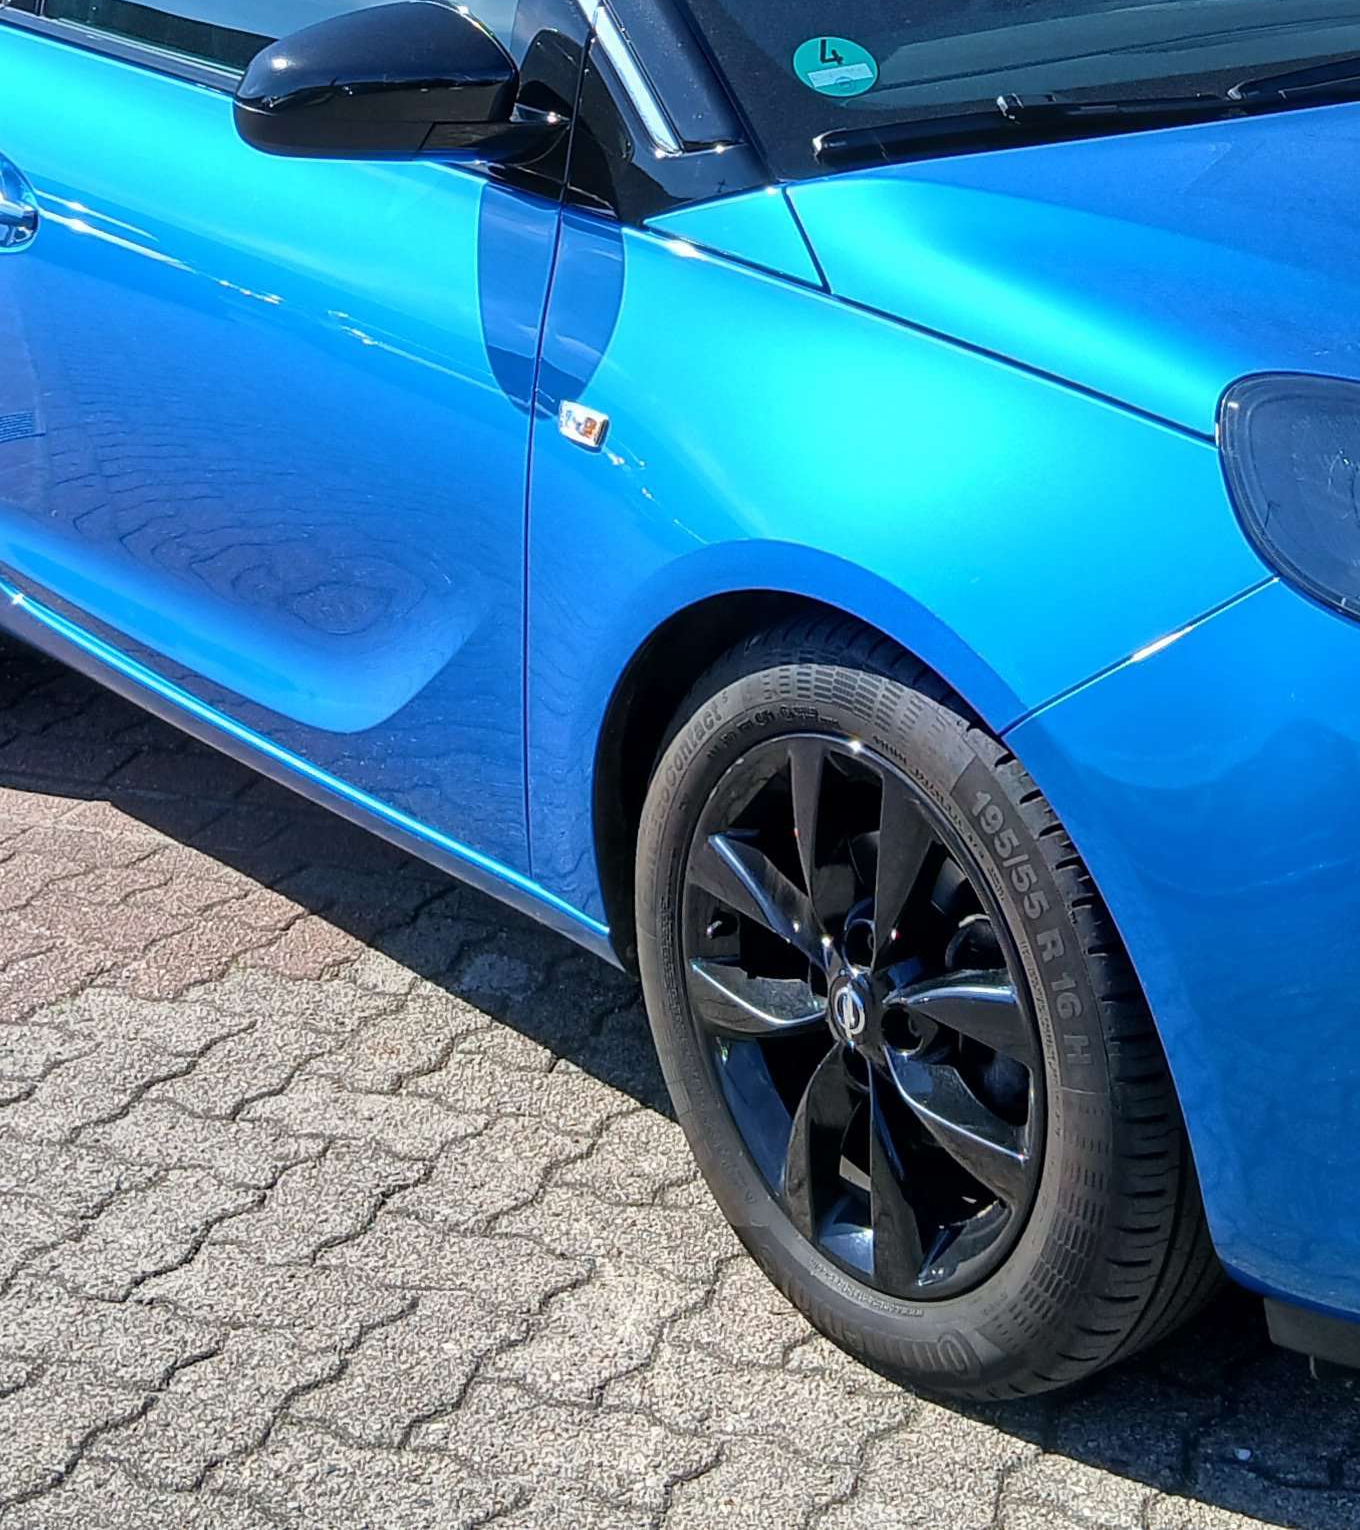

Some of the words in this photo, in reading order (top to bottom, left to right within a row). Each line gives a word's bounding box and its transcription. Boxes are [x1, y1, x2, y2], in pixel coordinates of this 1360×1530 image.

[819, 38, 843, 65] 4
[969, 788, 1051, 920] 195/55
[1036, 926, 1065, 963] R
[1050, 972, 1084, 1020] 16
[1063, 1033, 1093, 1066] H
